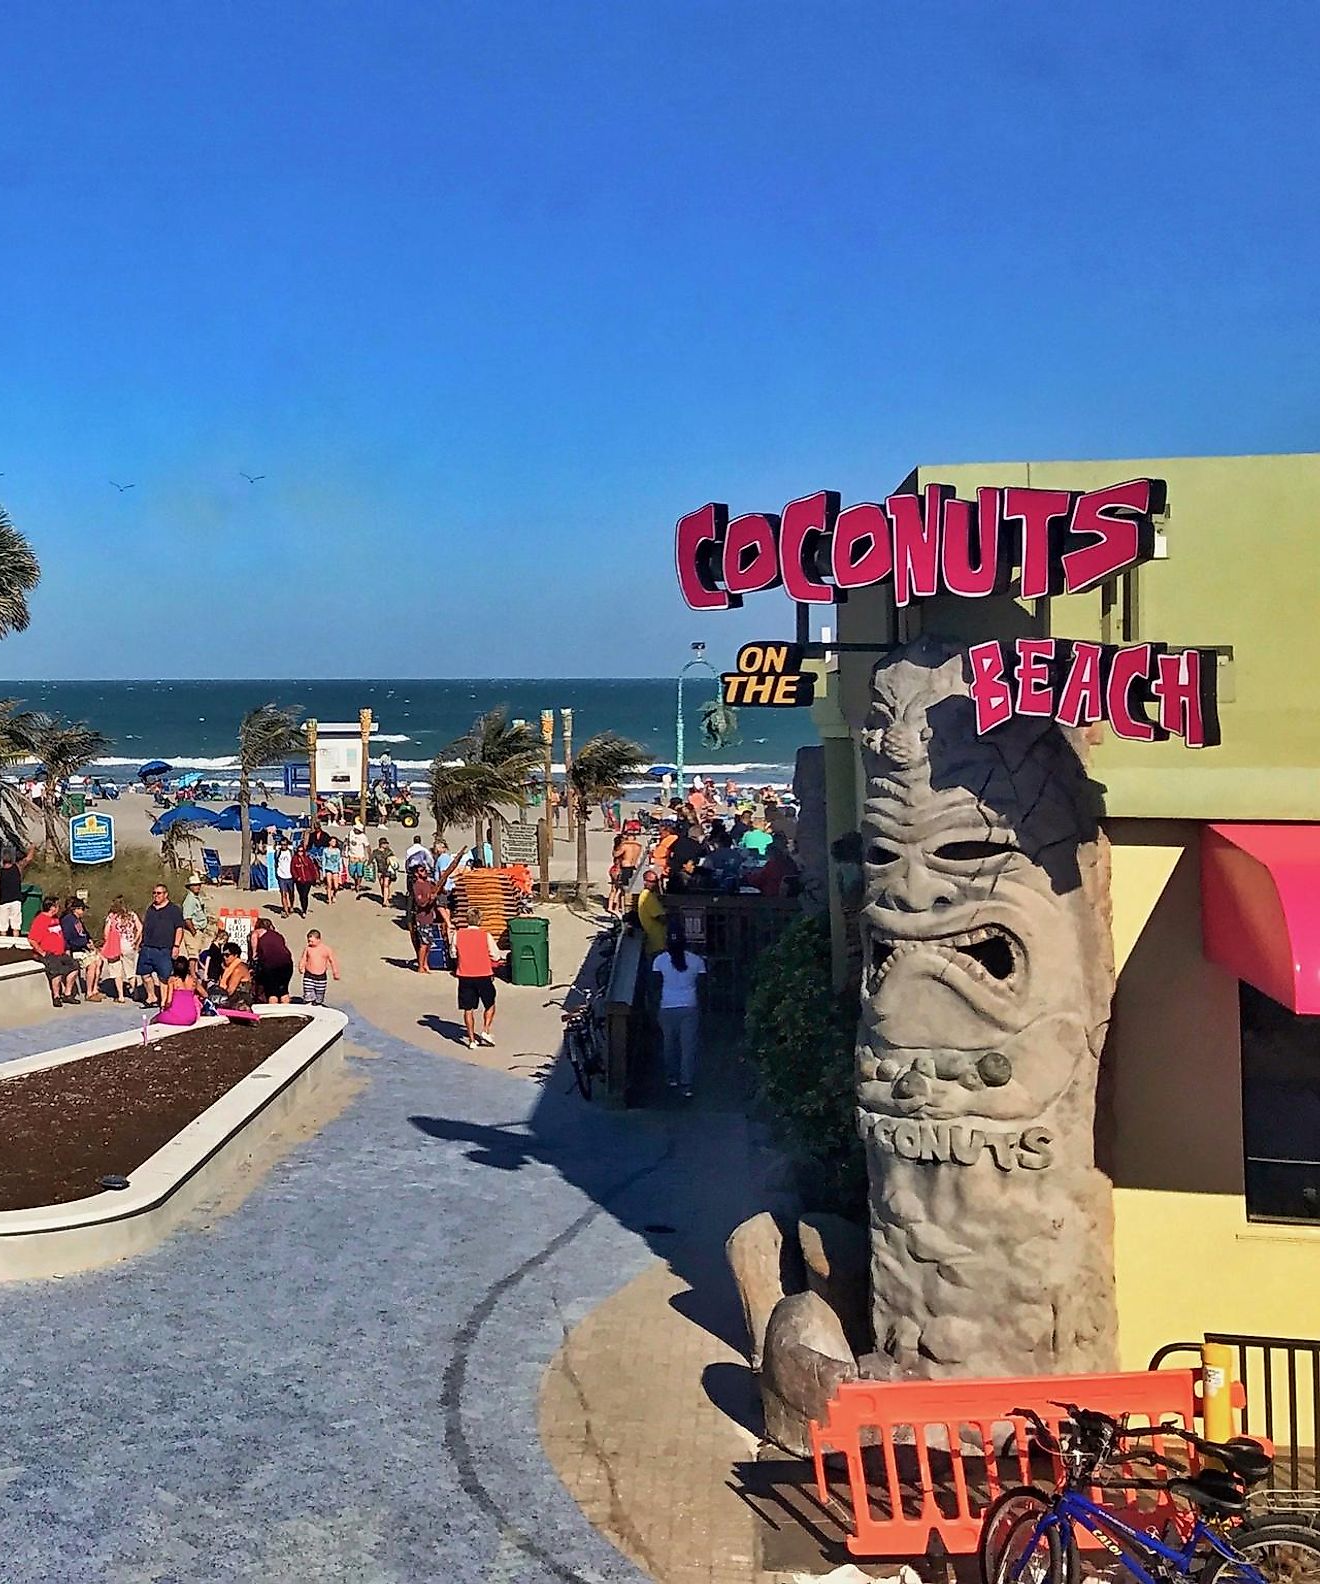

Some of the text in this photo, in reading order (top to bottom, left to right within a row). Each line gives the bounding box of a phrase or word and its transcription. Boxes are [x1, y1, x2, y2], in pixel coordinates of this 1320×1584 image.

[675, 478, 1151, 611] COCONUTS
[724, 675, 800, 704] THE
[739, 646, 788, 673] ON
[969, 638, 1205, 748] BEACH
